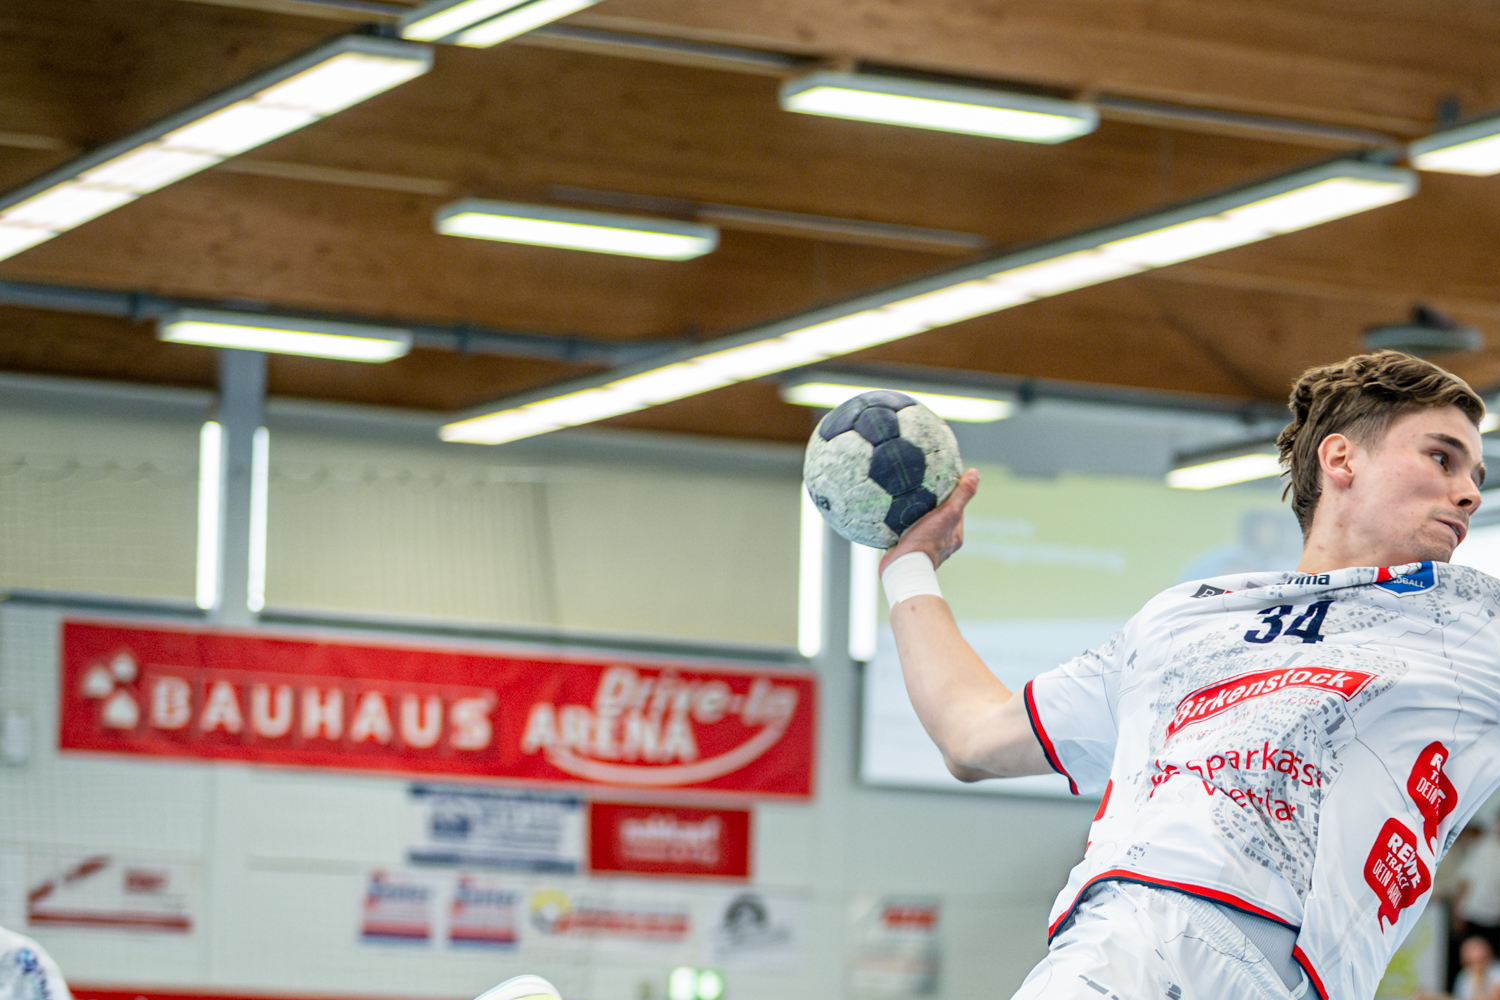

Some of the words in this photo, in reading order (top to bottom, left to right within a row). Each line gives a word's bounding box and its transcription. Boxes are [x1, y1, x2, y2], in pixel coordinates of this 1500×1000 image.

[1244, 601, 1334, 645] 34
[152, 675, 495, 752] BAUHAUS
[1172, 668, 1354, 730] Birkenstock
[522, 701, 701, 763] ARENA
[1372, 858, 1394, 888] DEIN
[1387, 832, 1422, 889] REWE
